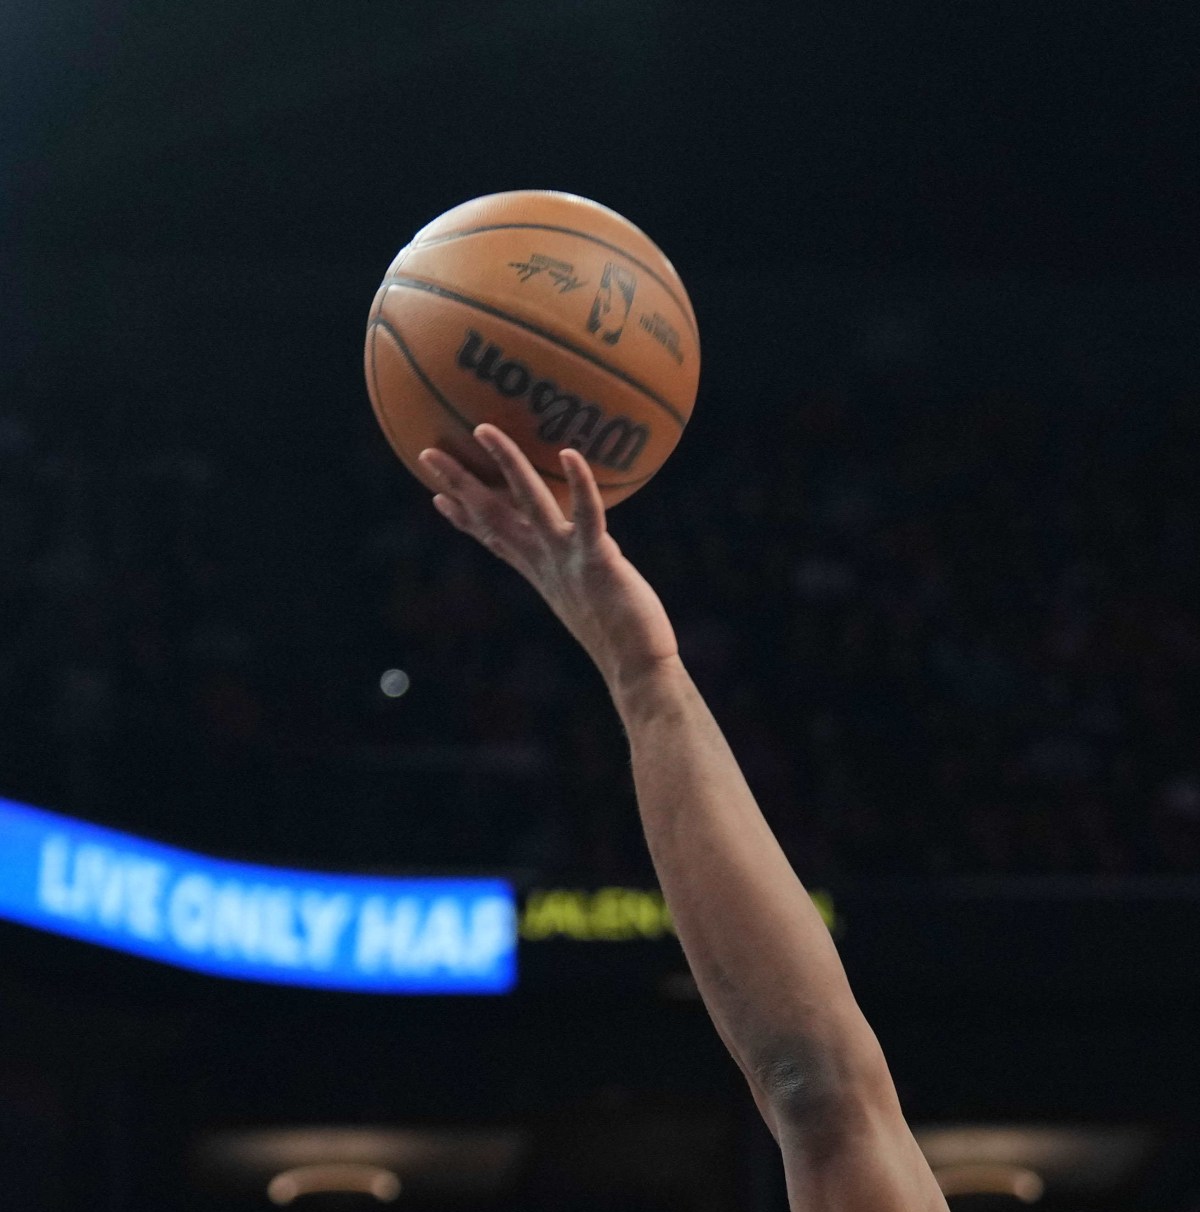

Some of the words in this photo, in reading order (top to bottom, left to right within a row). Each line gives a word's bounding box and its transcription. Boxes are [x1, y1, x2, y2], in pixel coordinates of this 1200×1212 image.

[456, 327, 650, 472] Wilson
[38, 833, 166, 939] LIVE
[168, 872, 351, 971] ONLY
